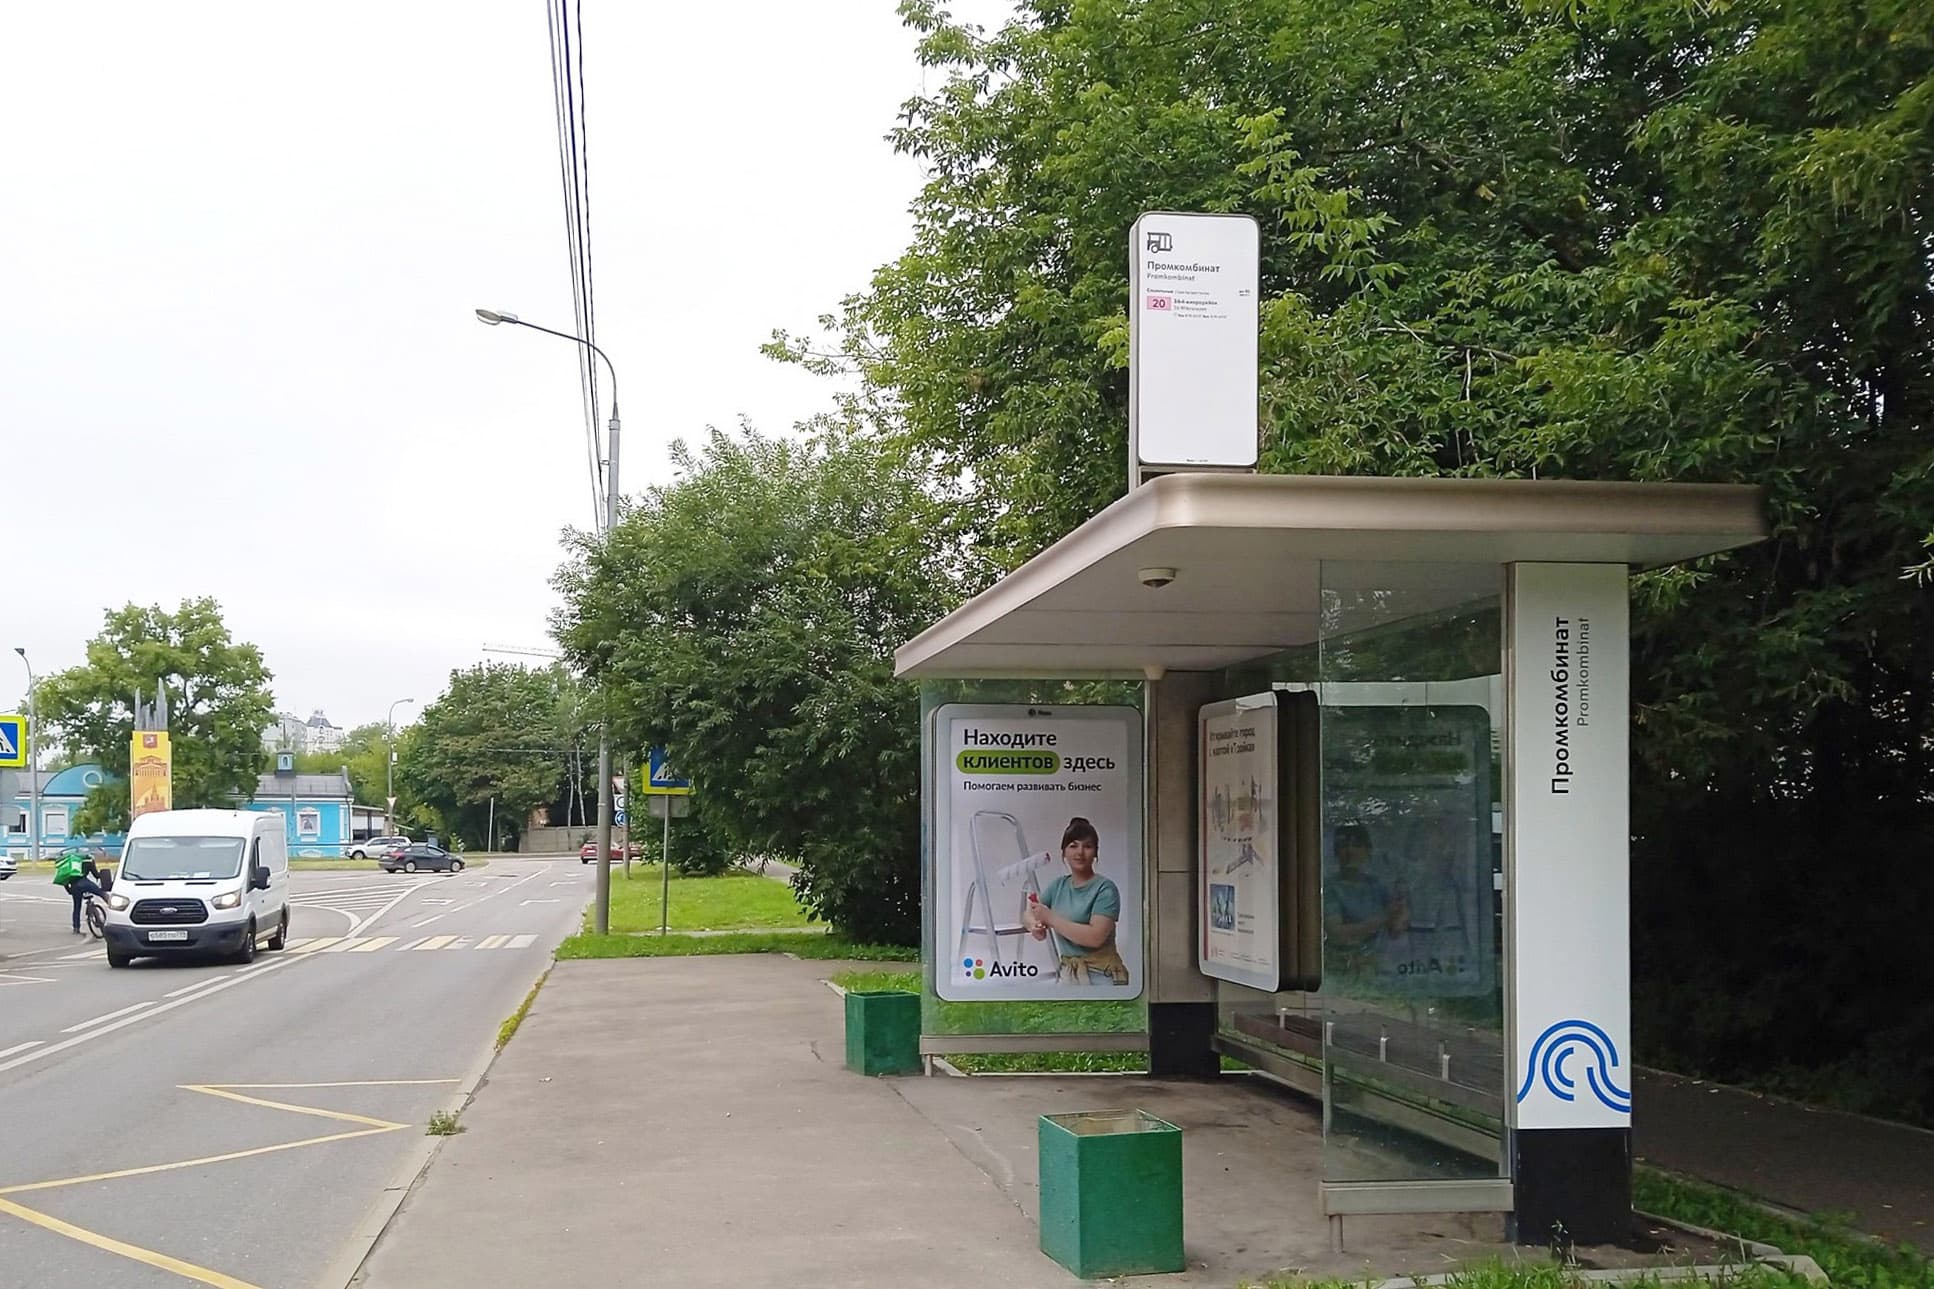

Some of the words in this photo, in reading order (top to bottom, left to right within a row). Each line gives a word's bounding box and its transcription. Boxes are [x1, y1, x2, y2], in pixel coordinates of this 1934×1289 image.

[1147, 261, 1220, 273] Промкомбинат
[1152, 298, 1166, 308] 20
[1576, 617, 1590, 727] Promkombinat
[1551, 617, 1573, 794] Промкомбинат
[963, 729, 1057, 748] Находите
[963, 755, 1053, 769] клиентов
[1063, 756, 1116, 772] здесь
[963, 781, 1015, 791] Помогаем
[1016, 782, 1066, 793] развивать
[1068, 782, 1102, 792] бизнес
[989, 961, 1038, 977] Avito
